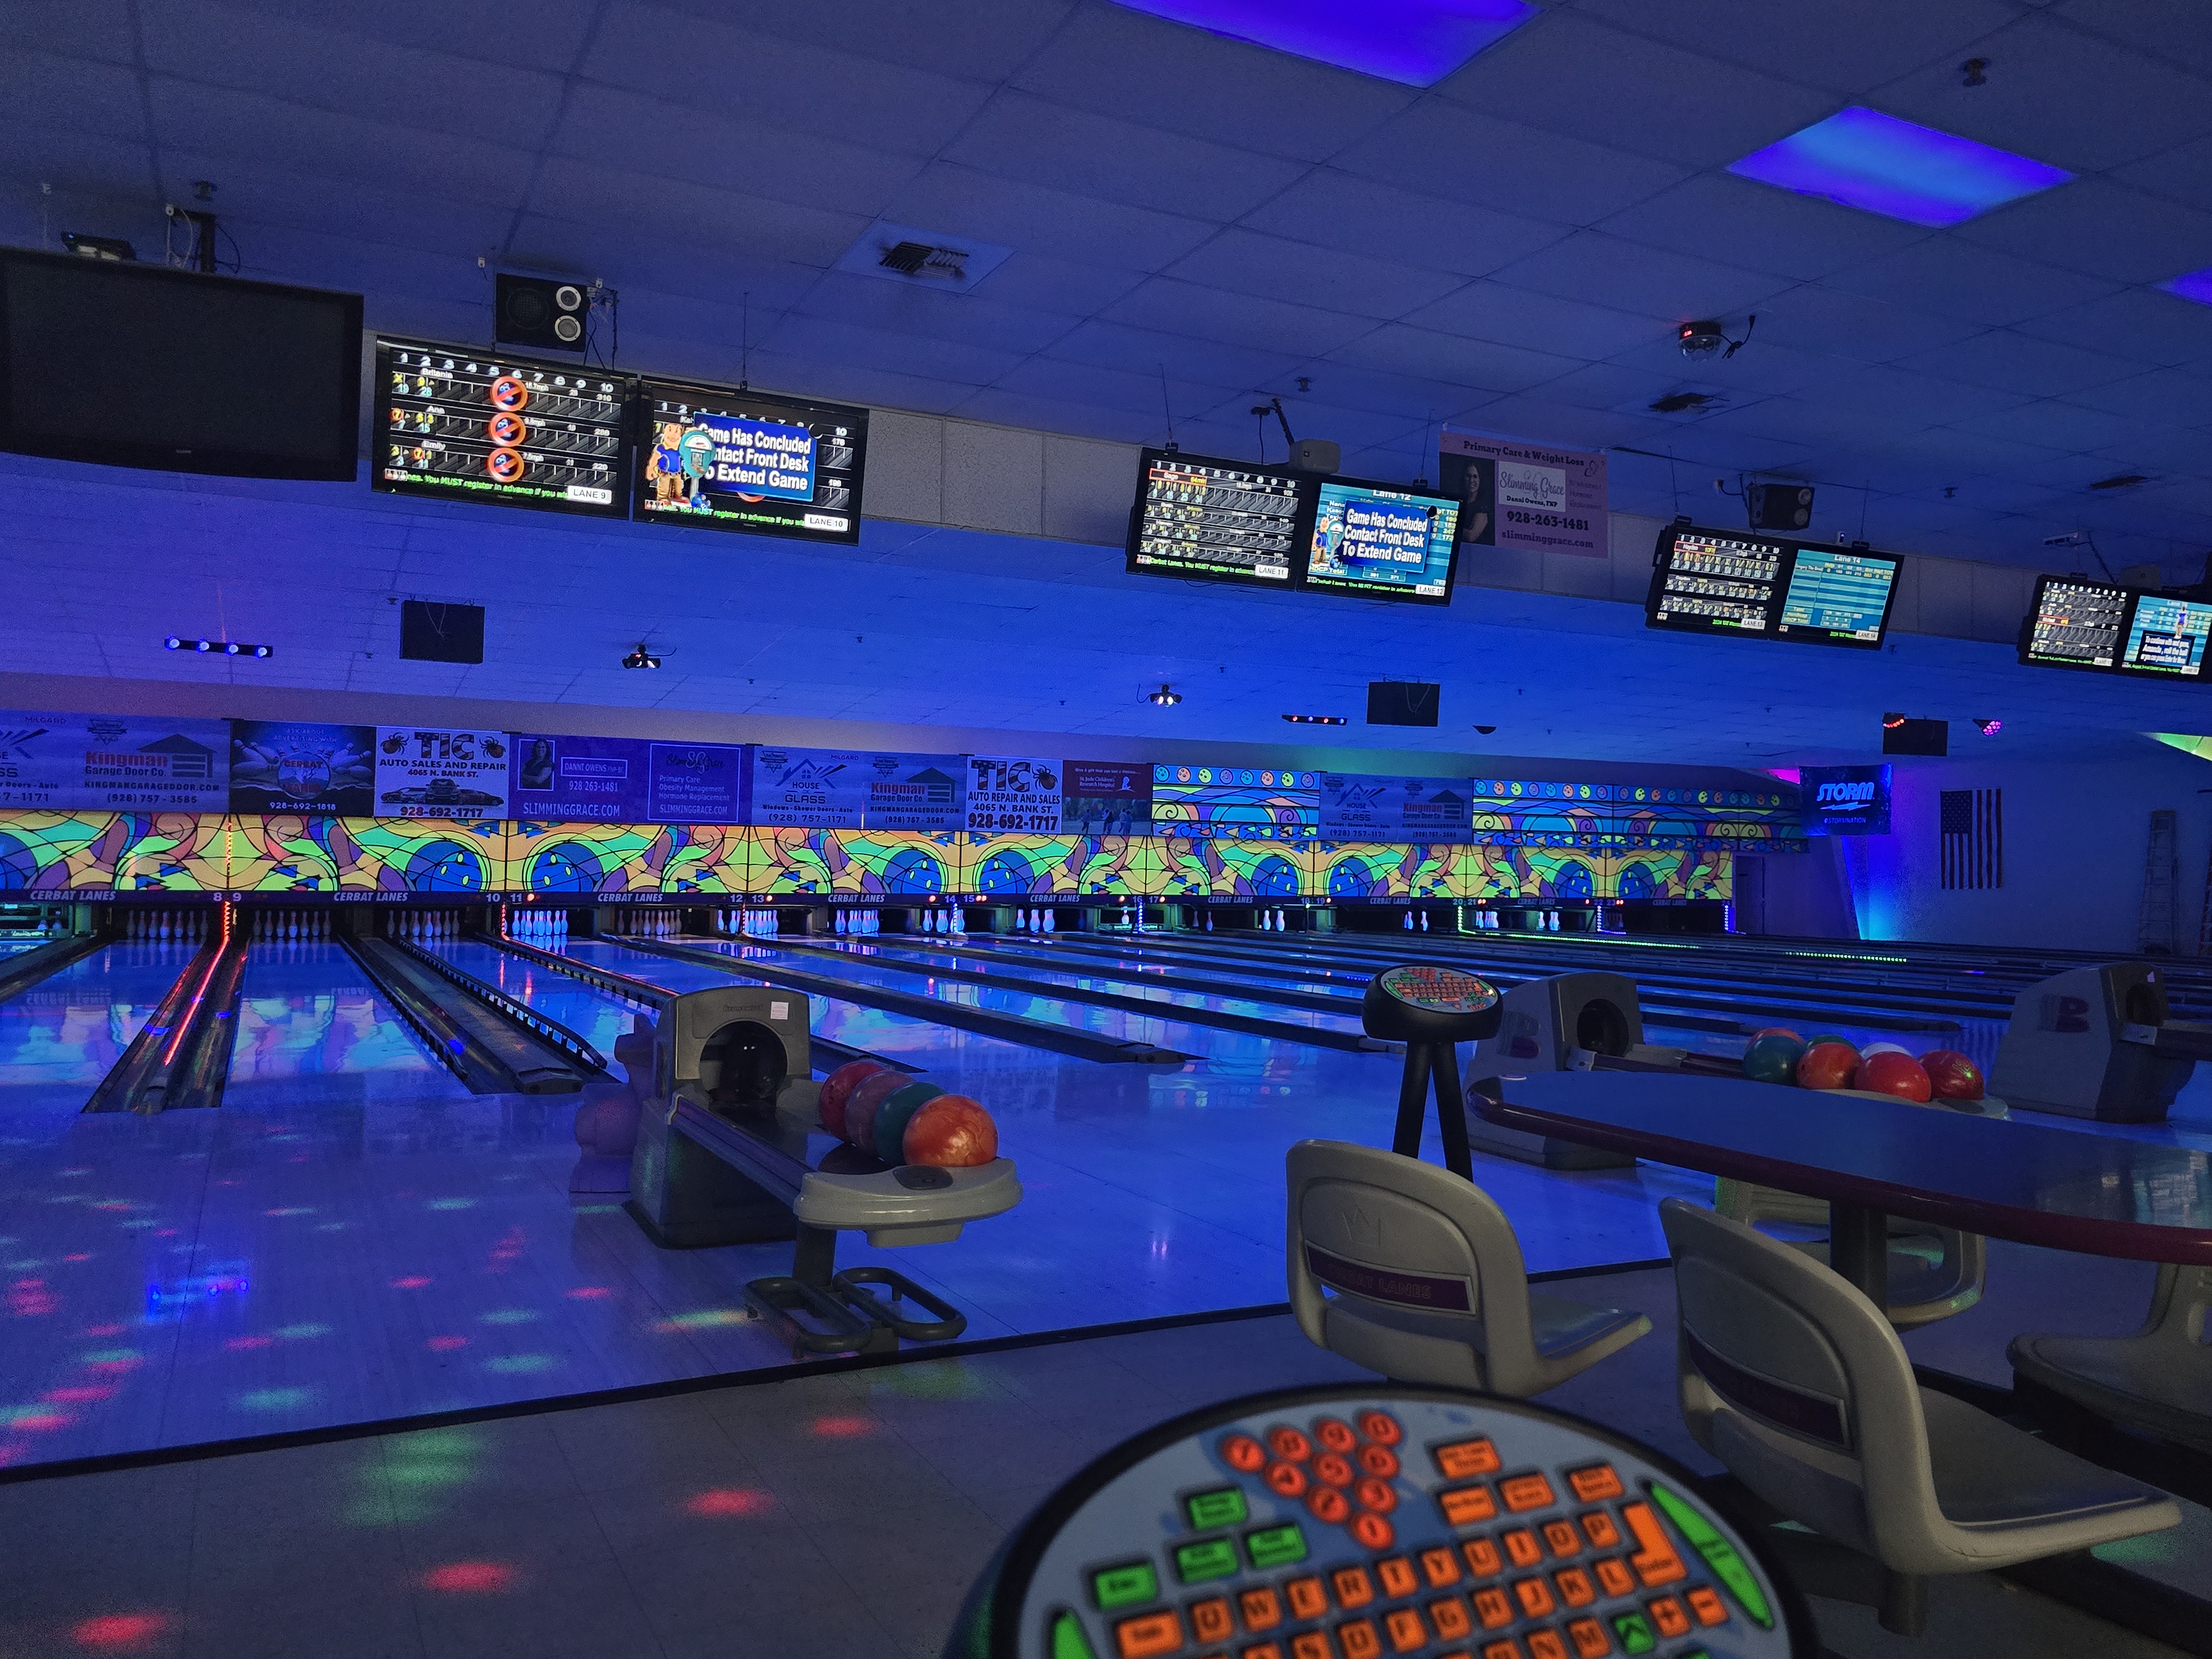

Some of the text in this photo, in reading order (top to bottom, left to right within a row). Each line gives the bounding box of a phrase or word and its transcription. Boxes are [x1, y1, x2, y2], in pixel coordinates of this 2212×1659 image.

[426, 405, 445, 414] Ann
[698, 423, 812, 455] Game Has Concluded
[421, 440, 446, 451] Emily
[1464, 441, 1584, 466] Primary Care Weight Loss
[746, 448, 809, 472] Front Desk
[717, 463, 808, 491] Extend Game
[441, 477, 533, 495] MUST register advance
[1500, 471, 1538, 497] Slimming
[1540, 477, 1564, 498] Grace
[573, 489, 599, 498] LANE
[1373, 489, 1397, 499] Lane
[810, 518, 832, 526] LANE
[1347, 508, 1428, 532] Game Has Concluded
[1507, 511, 1589, 531] 928-263-1481
[1344, 525, 1425, 548] Contact Front Desk
[1502, 530, 1593, 549] slimminggrace.com
[1342, 540, 1422, 564] To Extend Game
[415, 732, 474, 760] TIC
[85, 751, 168, 767] Kingman
[379, 759, 409, 767] AUTO
[411, 760, 442, 769] SALES
[471, 762, 507, 771] REPAIR
[565, 763, 585, 771] DANNI
[585, 764, 607, 772] OWENS
[85, 766, 149, 776] Garage Door
[971, 759, 1031, 792] TIC
[660, 775, 685, 784] Primary
[84, 781, 220, 791] KINGMANGARAGEDOOR.COM
[569, 780, 618, 792] 928 263-1481
[685, 785, 725, 793] Management
[871, 782, 926, 795] Kingman
[1817, 782, 1874, 801] STORM
[107, 794, 137, 804] (928)
[785, 794, 826, 804] GLASS
[871, 794, 895, 802] Garage
[968, 791, 1060, 805] AUTO REPAIR AND SALES
[269, 801, 337, 811] 928-692-1818
[523, 802, 620, 817] SLIMMINGGRACE.COM
[660, 804, 728, 815] SLIMMINGGRACE.COM
[974, 803, 996, 812] 4065
[1012, 805, 1039, 813] BANK
[1041, 806, 1054, 814] ST.
[1404, 803, 1442, 812] Kingman
[400, 806, 484, 818] 928-692-1717
[769, 813, 846, 823] (928) 757-1171
[885, 816, 905, 825] (928)
[968, 812, 1058, 831] 928-692-1717
[30, 891, 116, 900] CERBAT LANES
[213, 893, 222, 901] 8
[233, 893, 242, 901] 9
[333, 892, 408, 902] CERBAT LANES
[486, 893, 500, 902] 10
[510, 893, 522, 902] 11
[598, 893, 663, 902] CERBAT LANES
[752, 894, 764, 902] 13
[828, 894, 885, 902] CERBAT LANES
[1379, 1278, 1431, 1299] LANES
